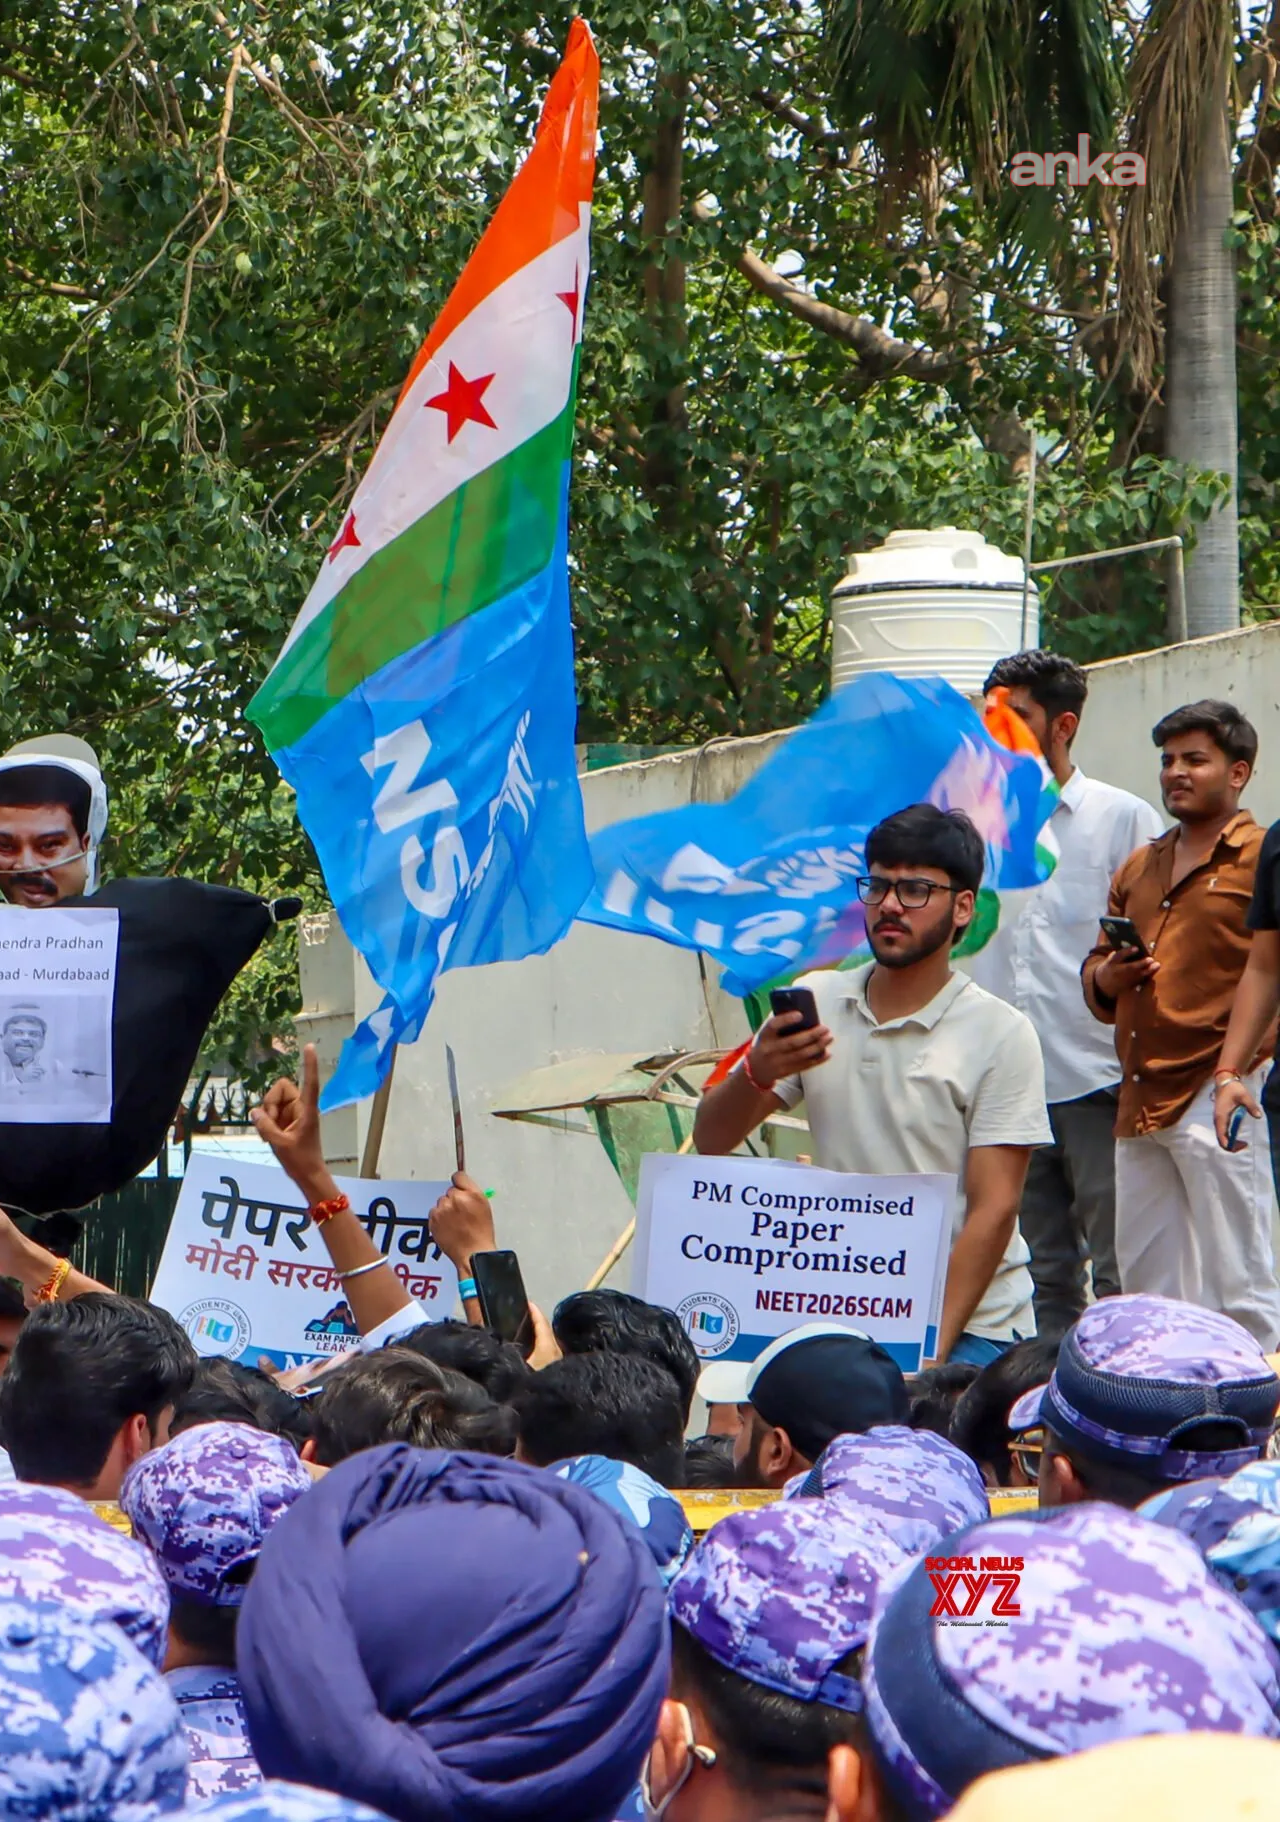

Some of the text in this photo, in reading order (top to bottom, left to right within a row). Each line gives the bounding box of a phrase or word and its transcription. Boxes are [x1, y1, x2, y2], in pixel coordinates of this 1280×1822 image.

[46, 936, 104, 950] Pradhan
[33, 967, 110, 981] Murdabaad
[692, 1180, 914, 1217] PM Compromised
[201, 1176, 442, 1263] पेपर ीक
[750, 1211, 844, 1248] Paper
[186, 1238, 259, 1281] मोदी
[681, 1234, 907, 1276] Compromised
[720, 1302, 736, 1325] UNION
[755, 1289, 913, 1319] NEET2026SCAM
[305, 1332, 332, 1344] EXAM
[315, 1342, 347, 1353] LEAK
[713, 1337, 732, 1353] INDIA
